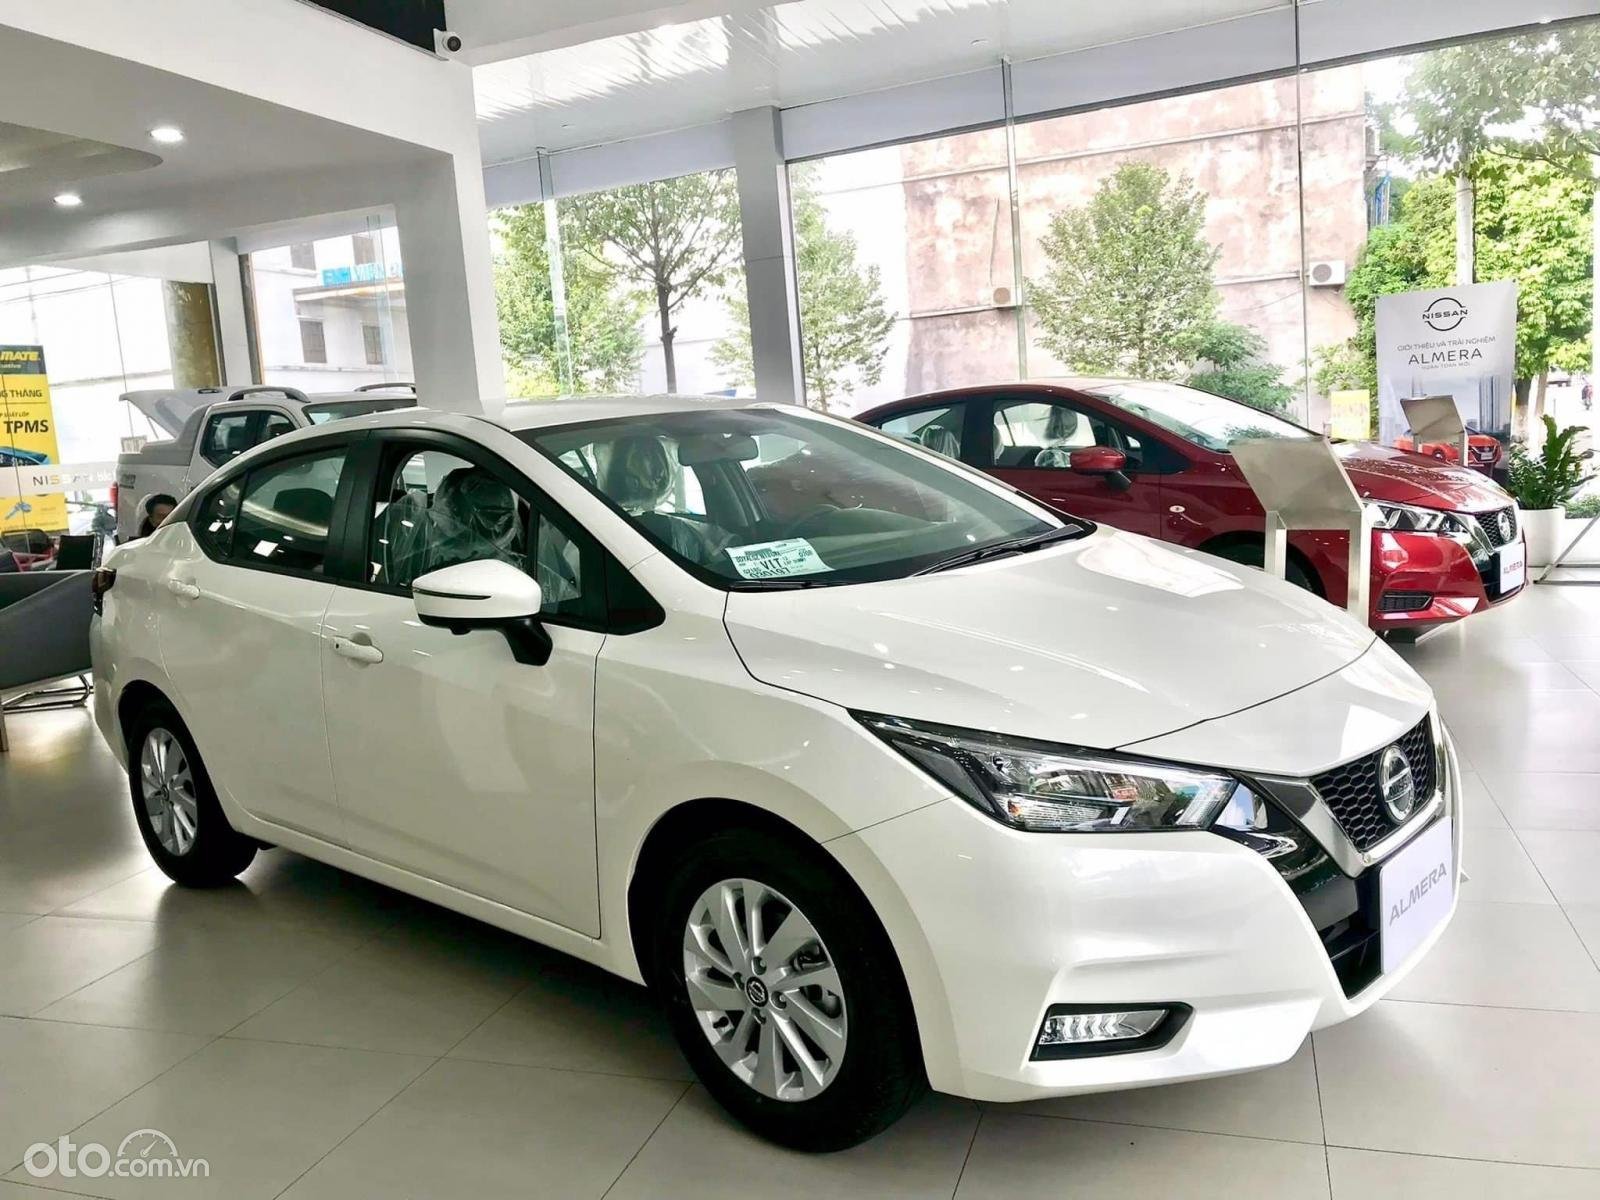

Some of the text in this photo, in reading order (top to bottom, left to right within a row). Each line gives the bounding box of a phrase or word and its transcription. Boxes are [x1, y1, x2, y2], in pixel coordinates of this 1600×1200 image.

[1422, 309, 1468, 320] NISSAN
[1408, 348, 1483, 365] ALMERA
[3, 419, 49, 434] TPMS
[1389, 861, 1447, 926] ALMERA
